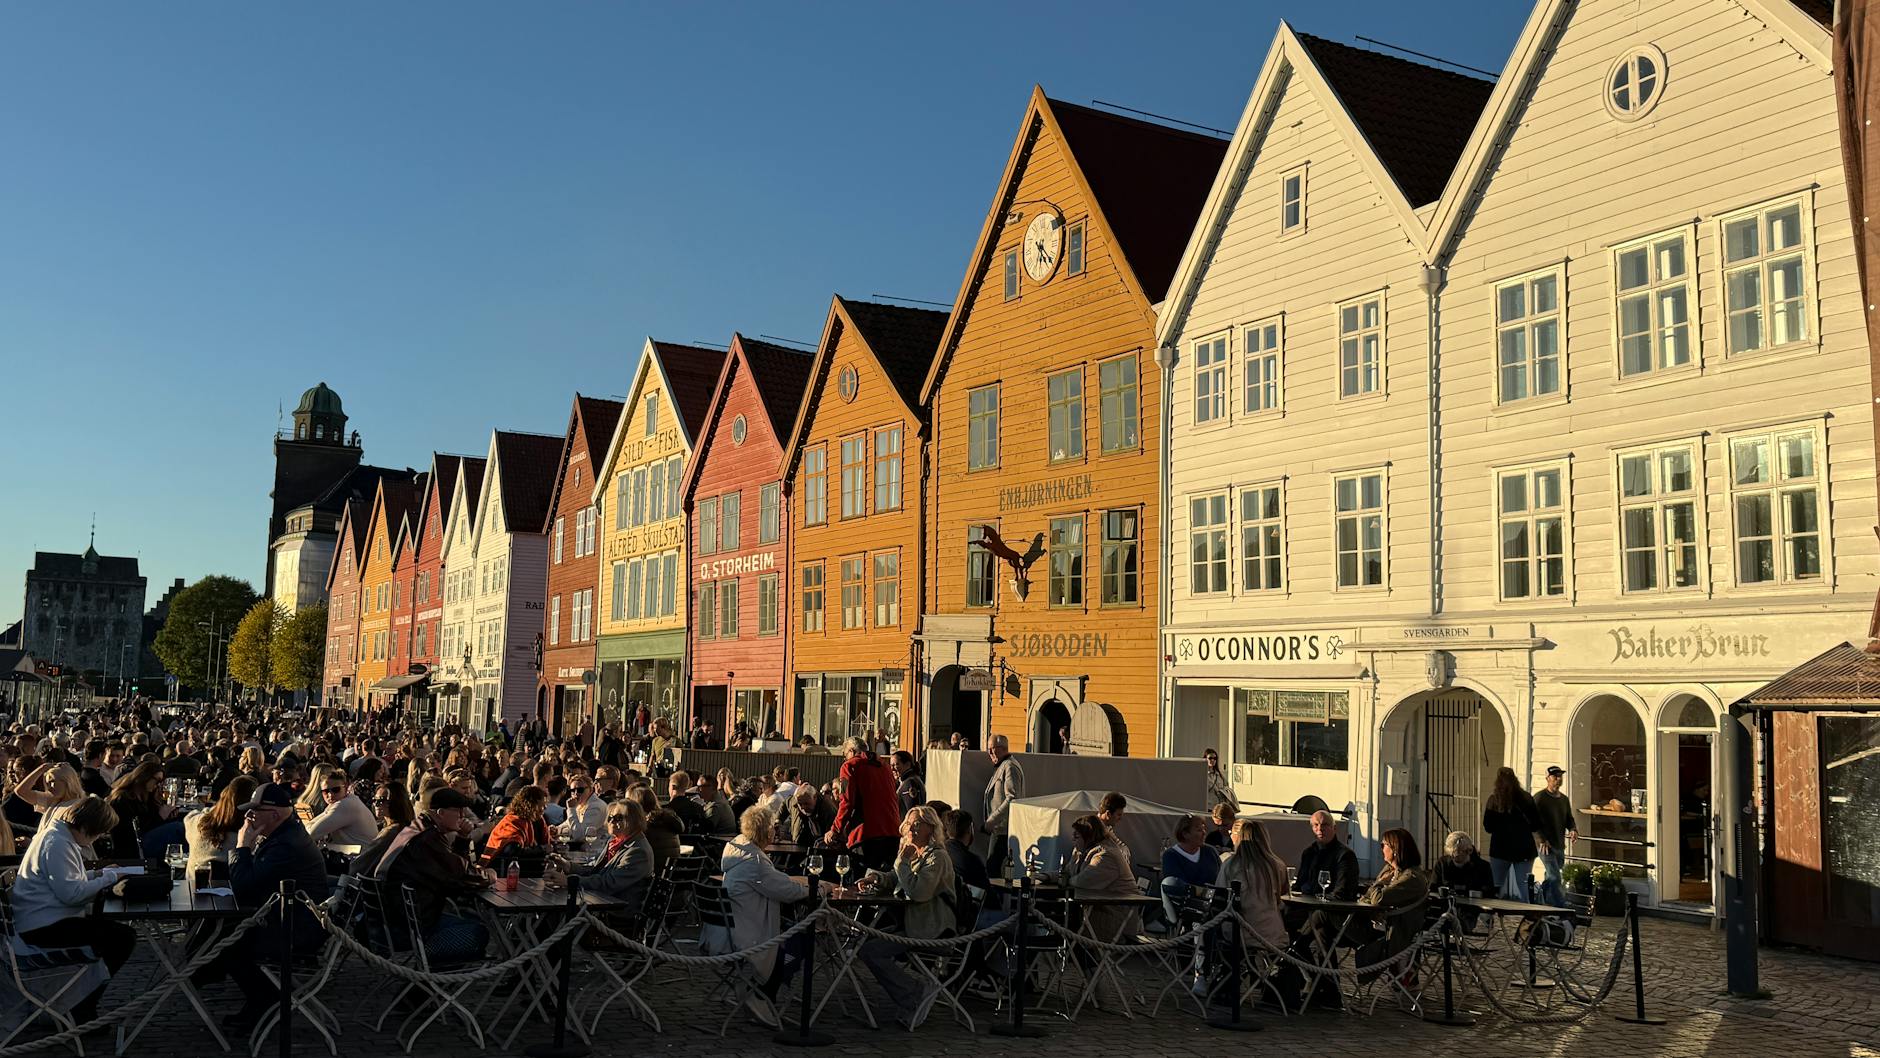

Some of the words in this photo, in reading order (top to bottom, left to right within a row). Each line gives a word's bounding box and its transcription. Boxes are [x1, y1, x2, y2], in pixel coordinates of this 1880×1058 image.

[623, 440, 644, 465] SILD
[658, 427, 680, 454] FISK
[999, 473, 1092, 512] ENHJØRNINGEN
[608, 534, 638, 558] ALFRED
[643, 523, 686, 551] SKULSTAD
[700, 563, 711, 580] O.
[712, 551, 775, 578] STORHEIM
[1009, 632, 1108, 658] SJØBODEN
[1198, 634, 1320, 661] O'CONNOR'S
[1607, 625, 1693, 665] Baker
[1685, 623, 1772, 664] Brun
